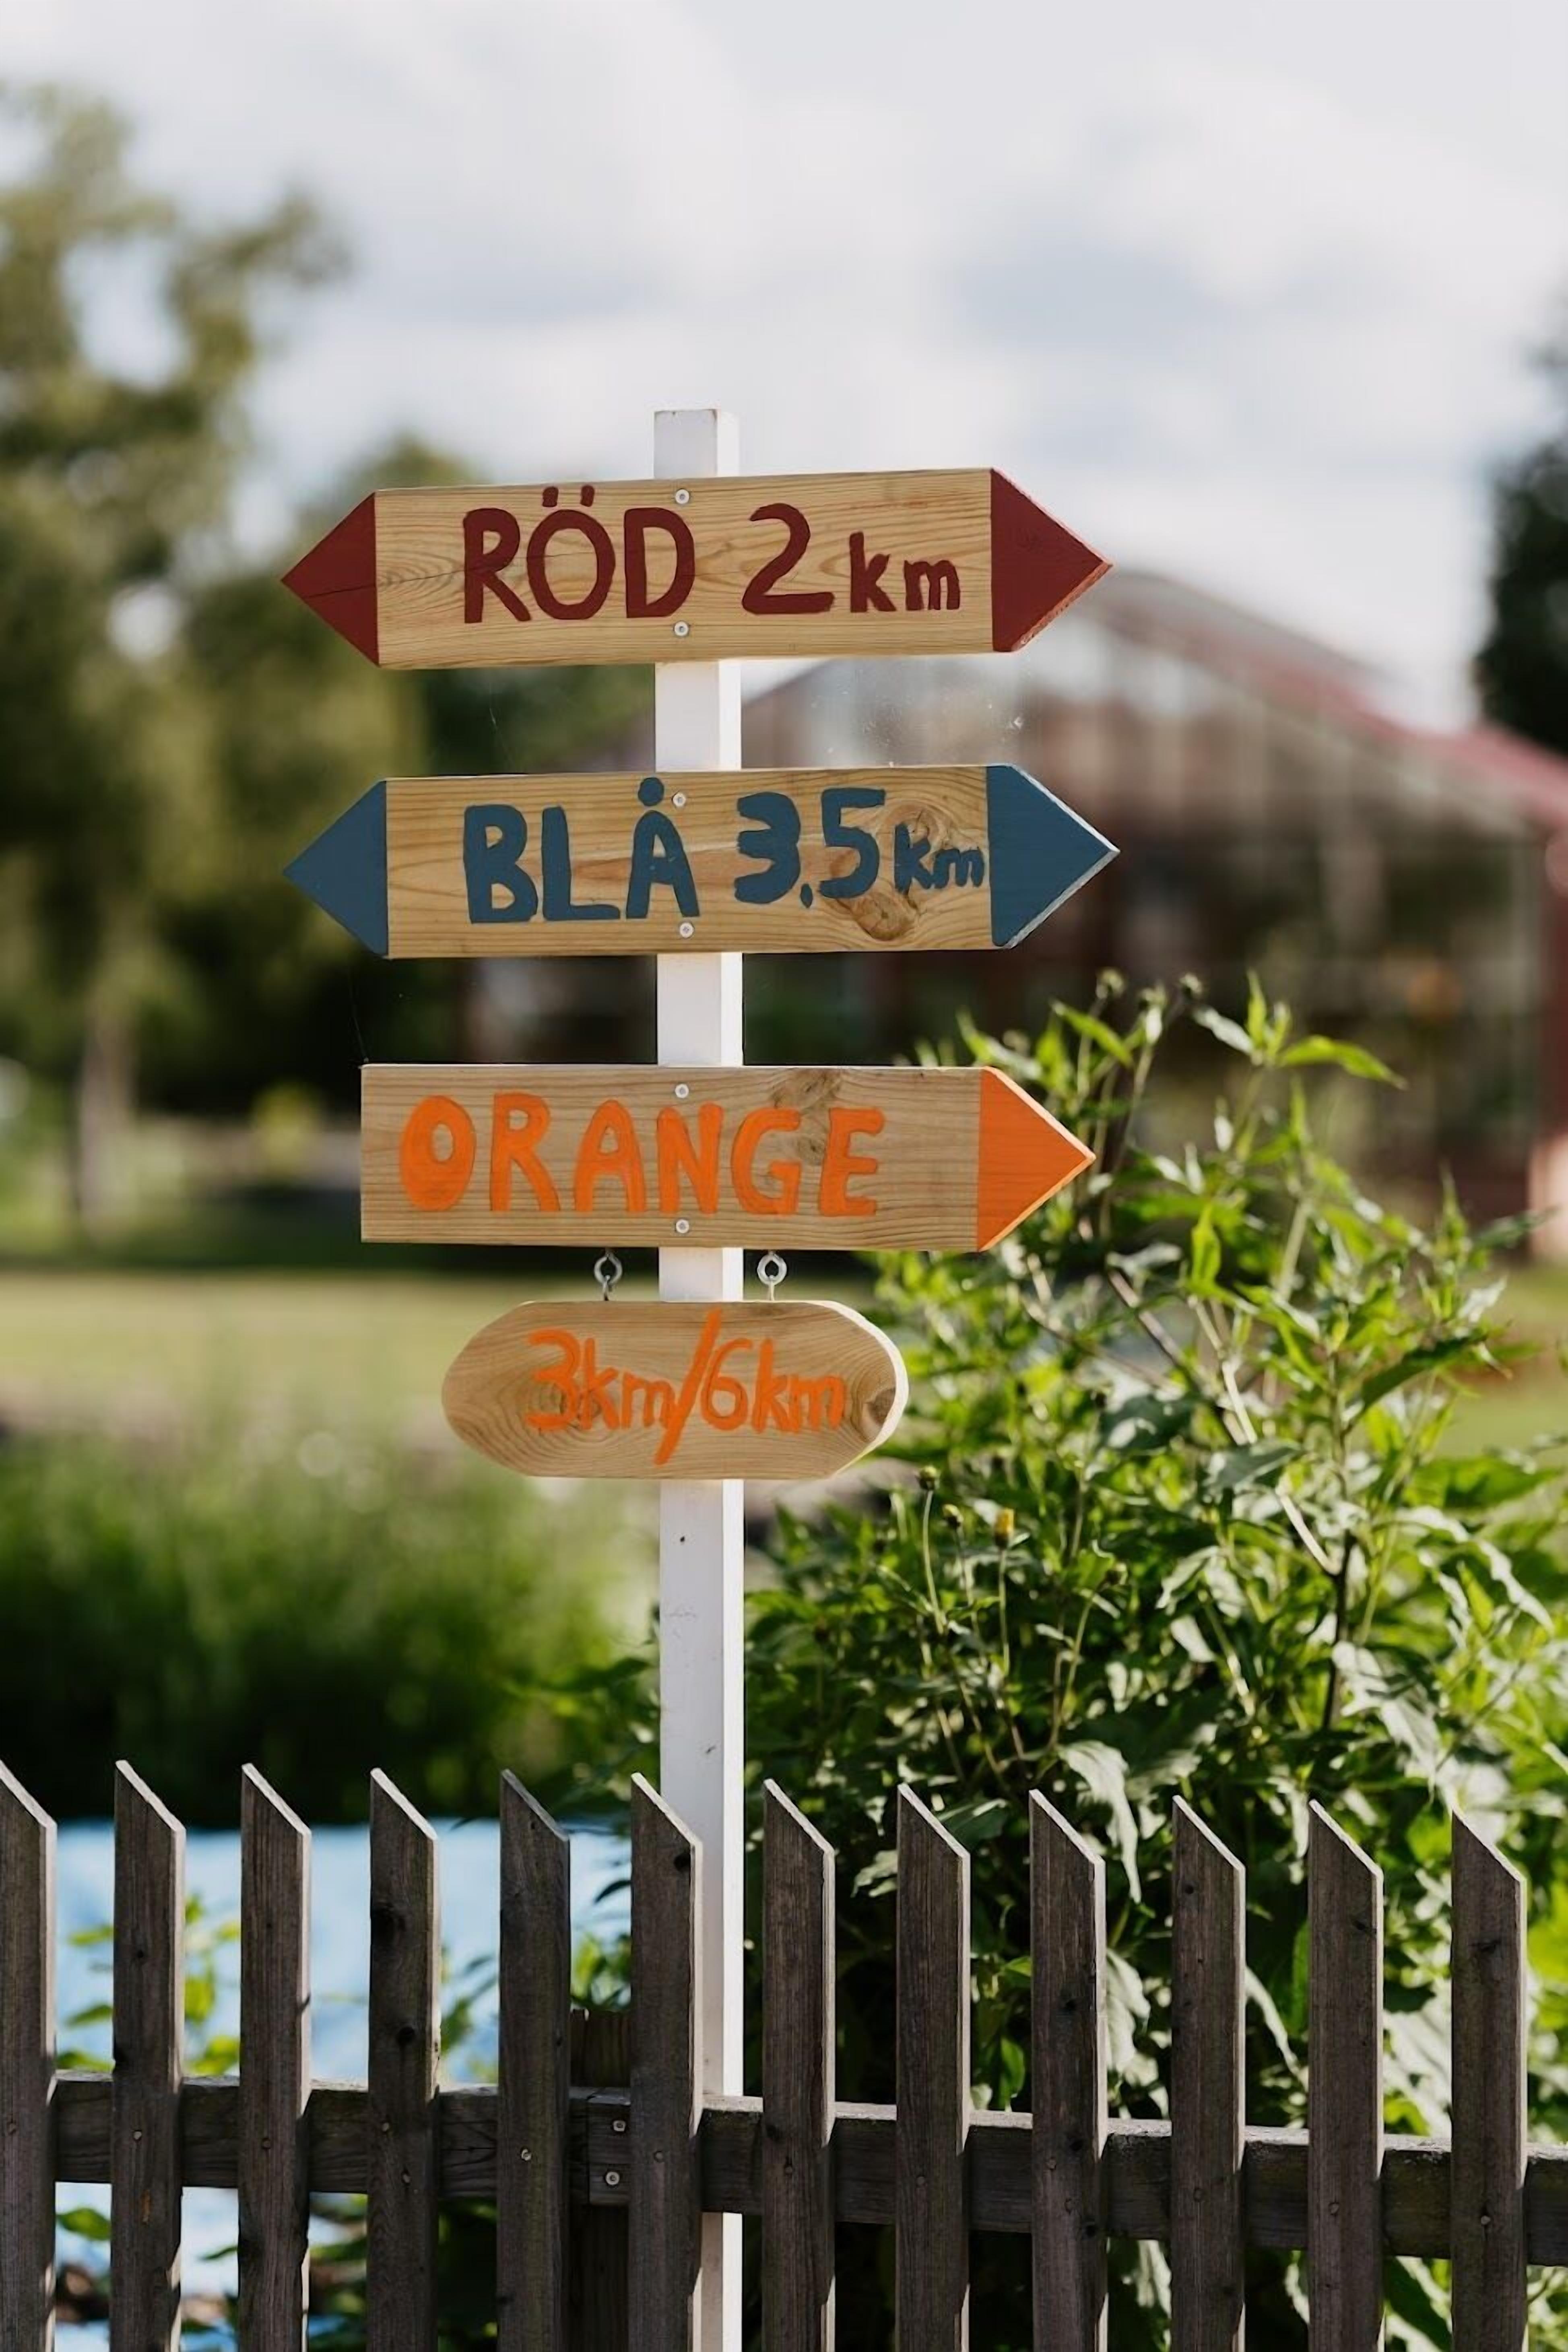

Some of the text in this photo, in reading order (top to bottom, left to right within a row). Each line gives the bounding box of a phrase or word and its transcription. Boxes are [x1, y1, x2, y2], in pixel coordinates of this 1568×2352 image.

[462, 486, 961, 623] RÖD 2 km
[463, 777, 985, 923] BLÅ 3,5 km
[399, 1091, 886, 1217] ORANGE
[526, 1308, 846, 1467] 3km/6km
